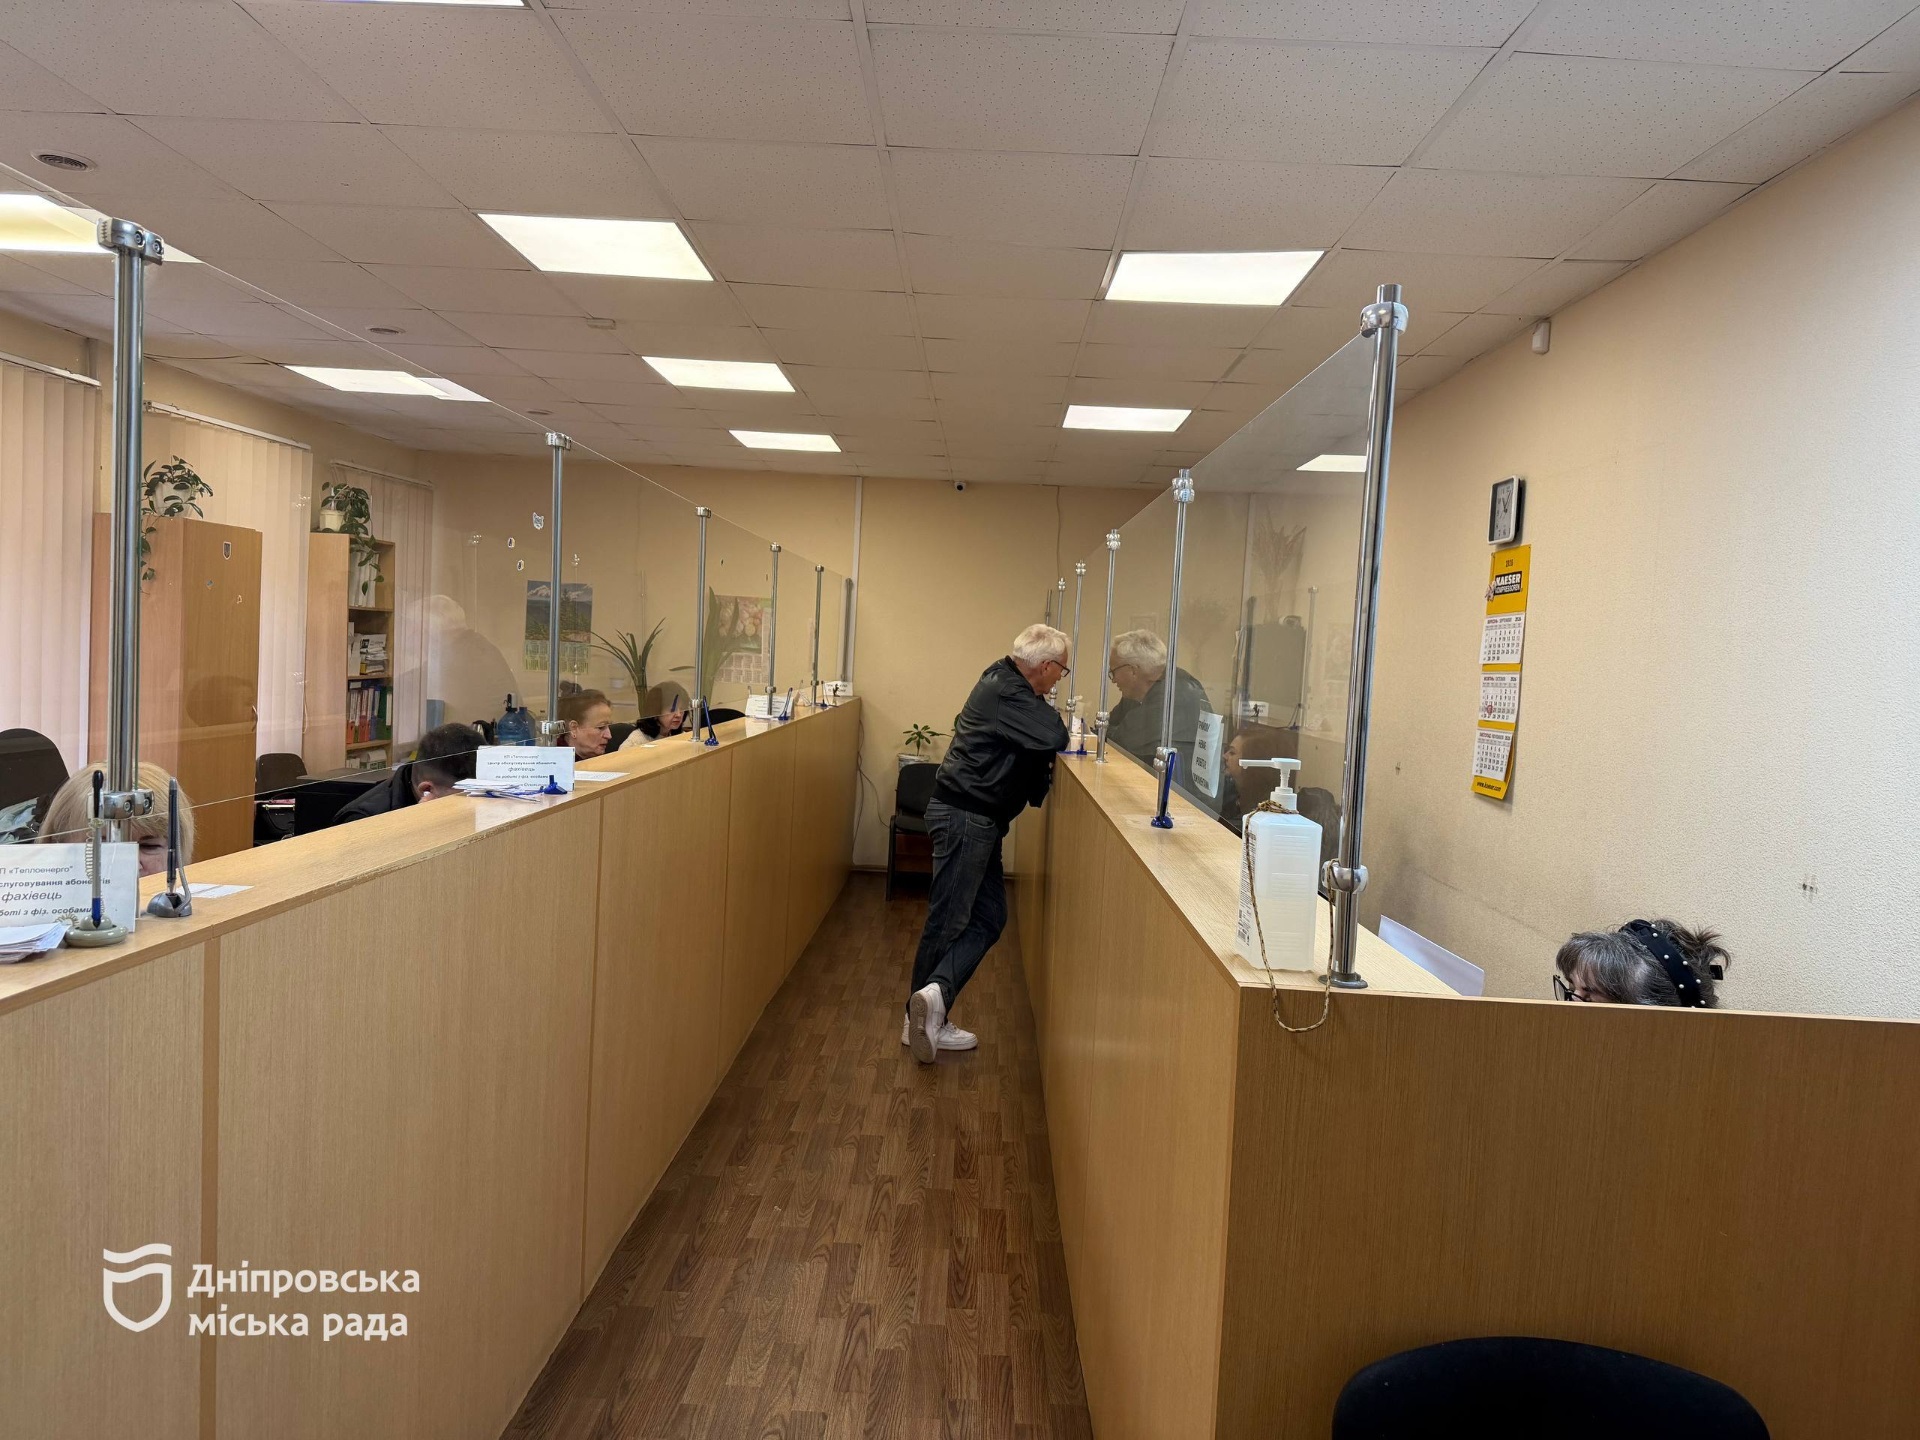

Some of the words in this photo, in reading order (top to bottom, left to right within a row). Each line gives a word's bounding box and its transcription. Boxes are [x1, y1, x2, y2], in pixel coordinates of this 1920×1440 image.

[1496, 573, 1521, 585] KAESER
[1, 891, 62, 903] фахівець
[30, 908, 49, 916] фіз.
